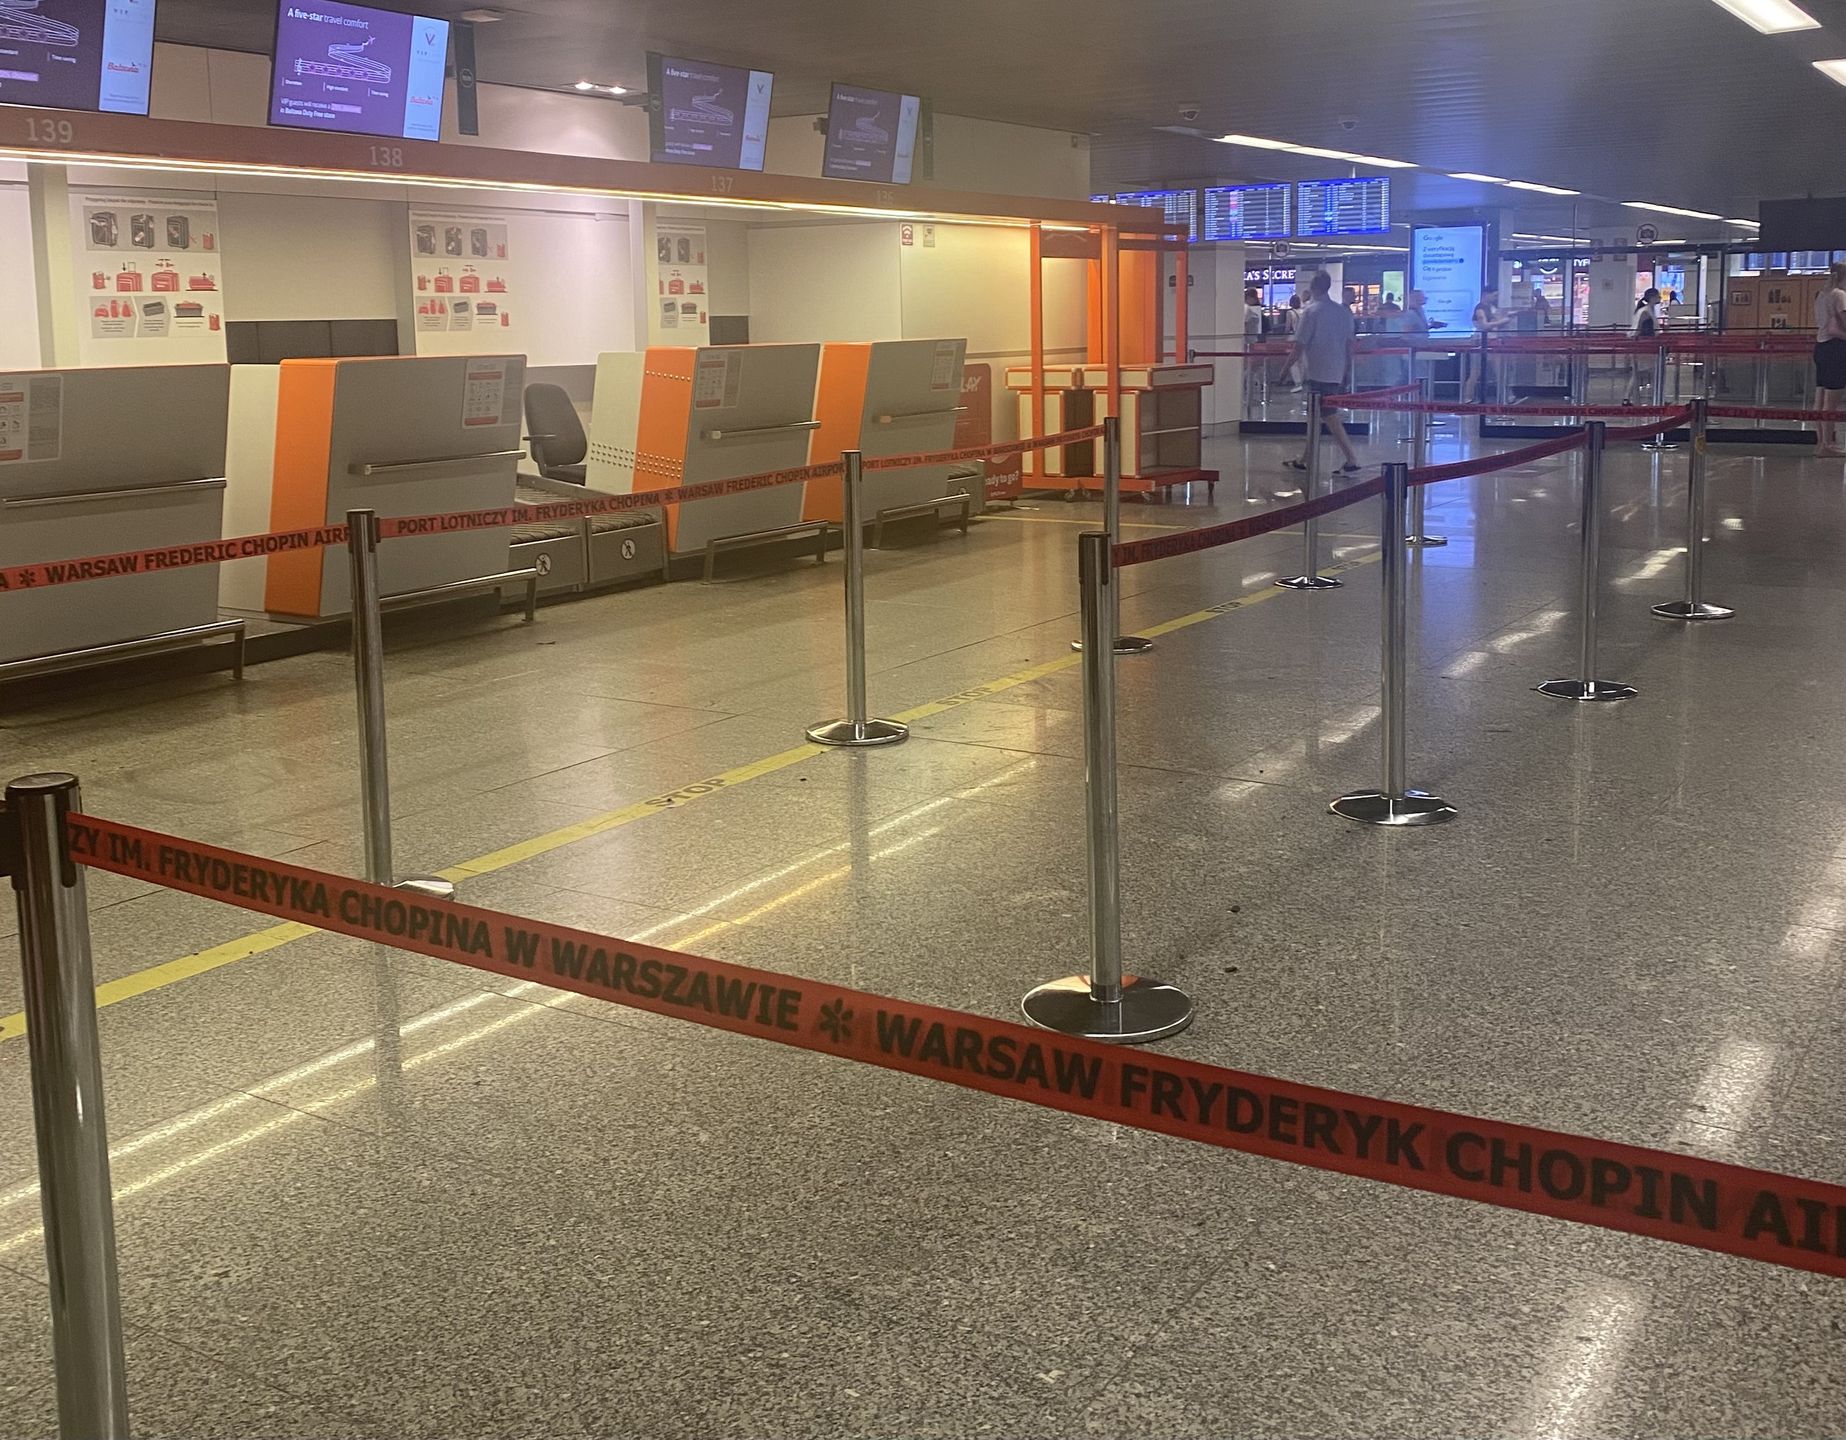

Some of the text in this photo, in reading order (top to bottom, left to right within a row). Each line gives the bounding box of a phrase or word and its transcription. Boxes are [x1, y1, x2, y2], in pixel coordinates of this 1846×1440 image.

[287, 7, 369, 30] A five-star travel comfort
[26, 117, 73, 144] 139
[369, 146, 403, 167] 138
[711, 175, 734, 192] 137
[1262, 269, 1297, 281] SCRE
[397, 517, 437, 534] PORT
[440, 510, 509, 531] LOTNICZY
[512, 507, 532, 523] IM.
[536, 498, 607, 521] FRYDERYKA
[609, 493, 660, 511] CHOPINA
[678, 482, 724, 500] WARSAW
[727, 473, 773, 491] FREDERIC
[775, 468, 811, 485] CHOPIN
[45, 554, 138, 584] WARSAW
[144, 540, 238, 569] FREDERIC
[241, 532, 309, 558] CHOPIN
[935, 685, 993, 706] STOP
[644, 778, 725, 808] STOP
[108, 833, 152, 871] IM.
[158, 845, 331, 919] FRYDERYKA
[338, 889, 493, 959] CHOPINA
[504, 926, 541, 969] W
[549, 938, 803, 1033] WARSZAWIE
[874, 1009, 1104, 1101] WARSAW
[1120, 1062, 1427, 1172] FRYDERYK
[1444, 1130, 1718, 1232] CHOPIN
